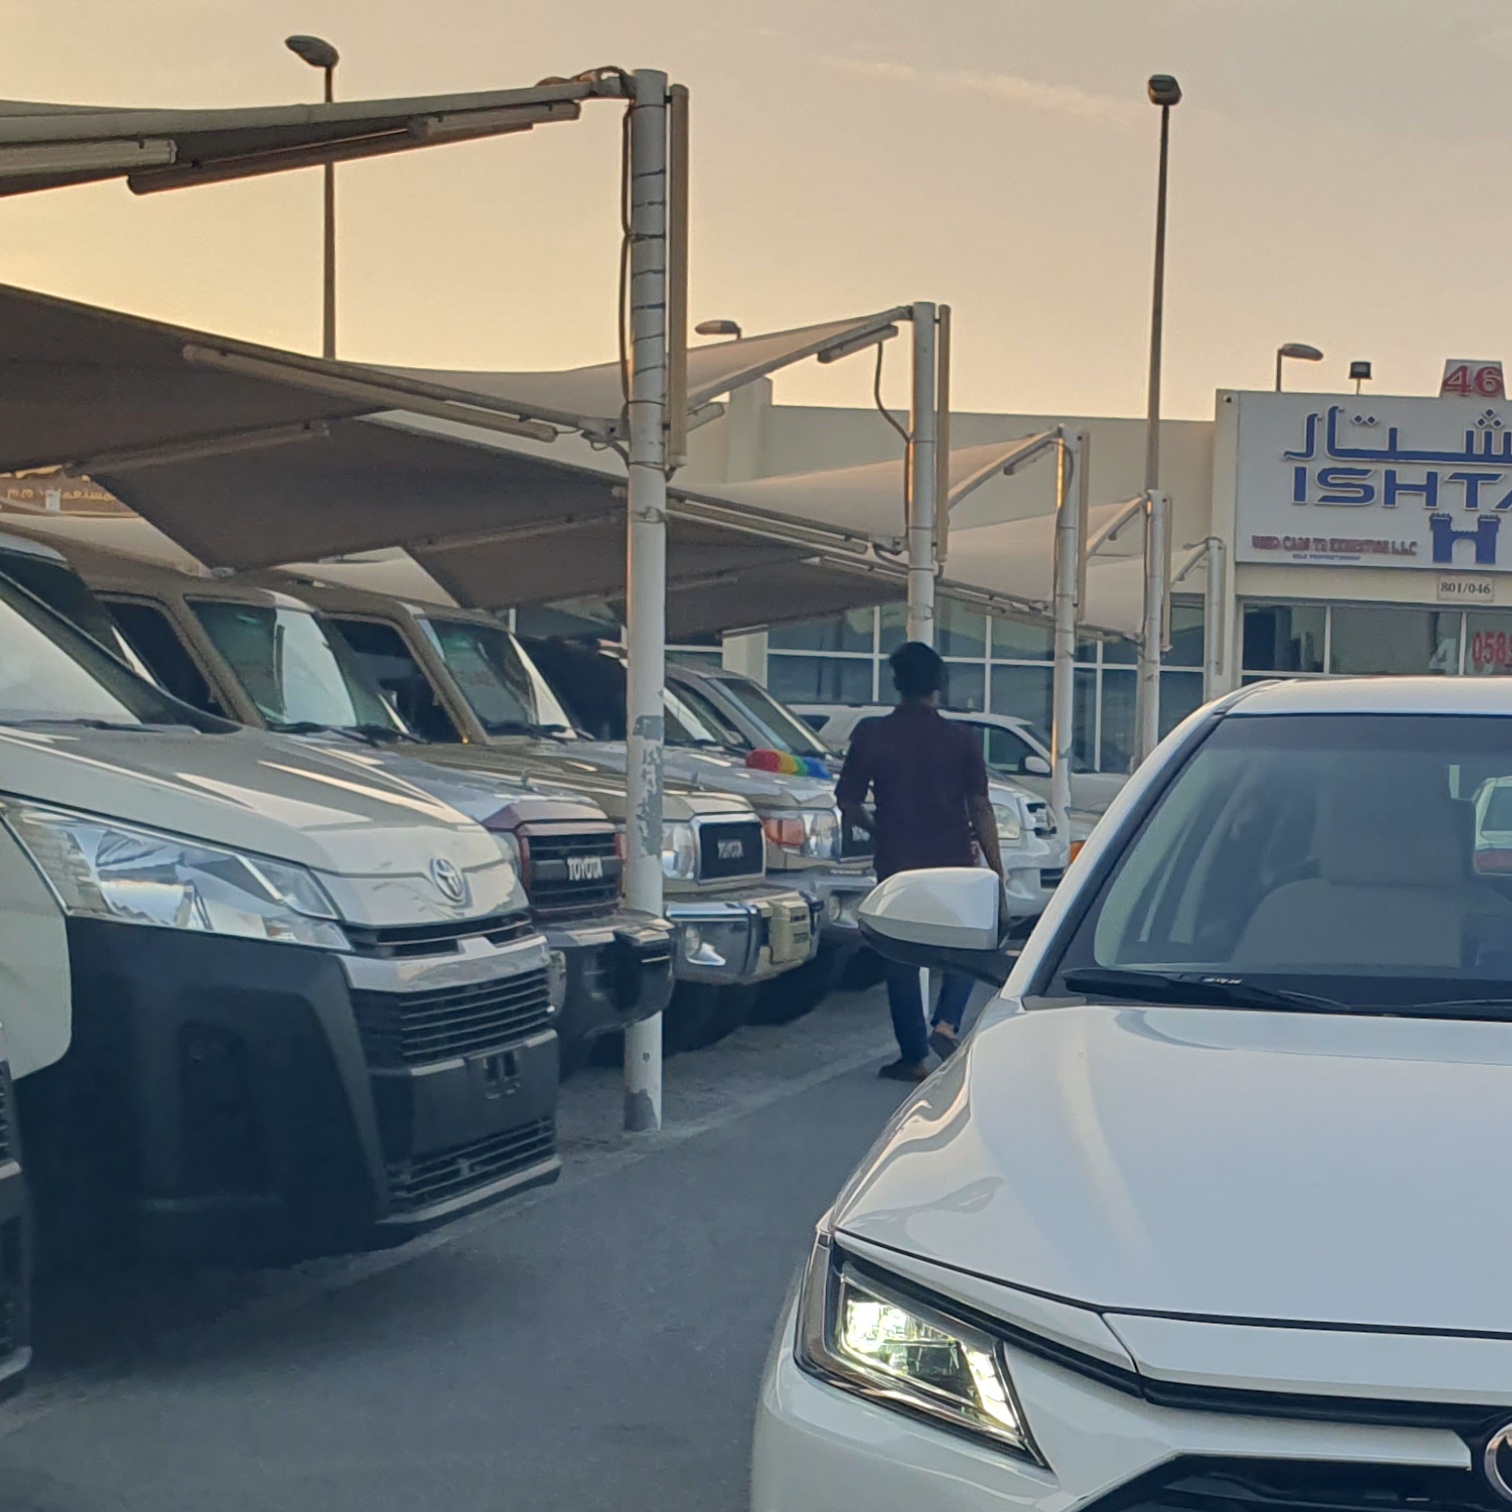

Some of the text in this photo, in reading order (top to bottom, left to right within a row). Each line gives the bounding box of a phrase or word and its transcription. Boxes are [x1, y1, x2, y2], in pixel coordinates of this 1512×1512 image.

[1443, 365, 1503, 396] 46
[1440, 581, 1492, 595] 801/046
[567, 857, 604, 881] TOYOTA
